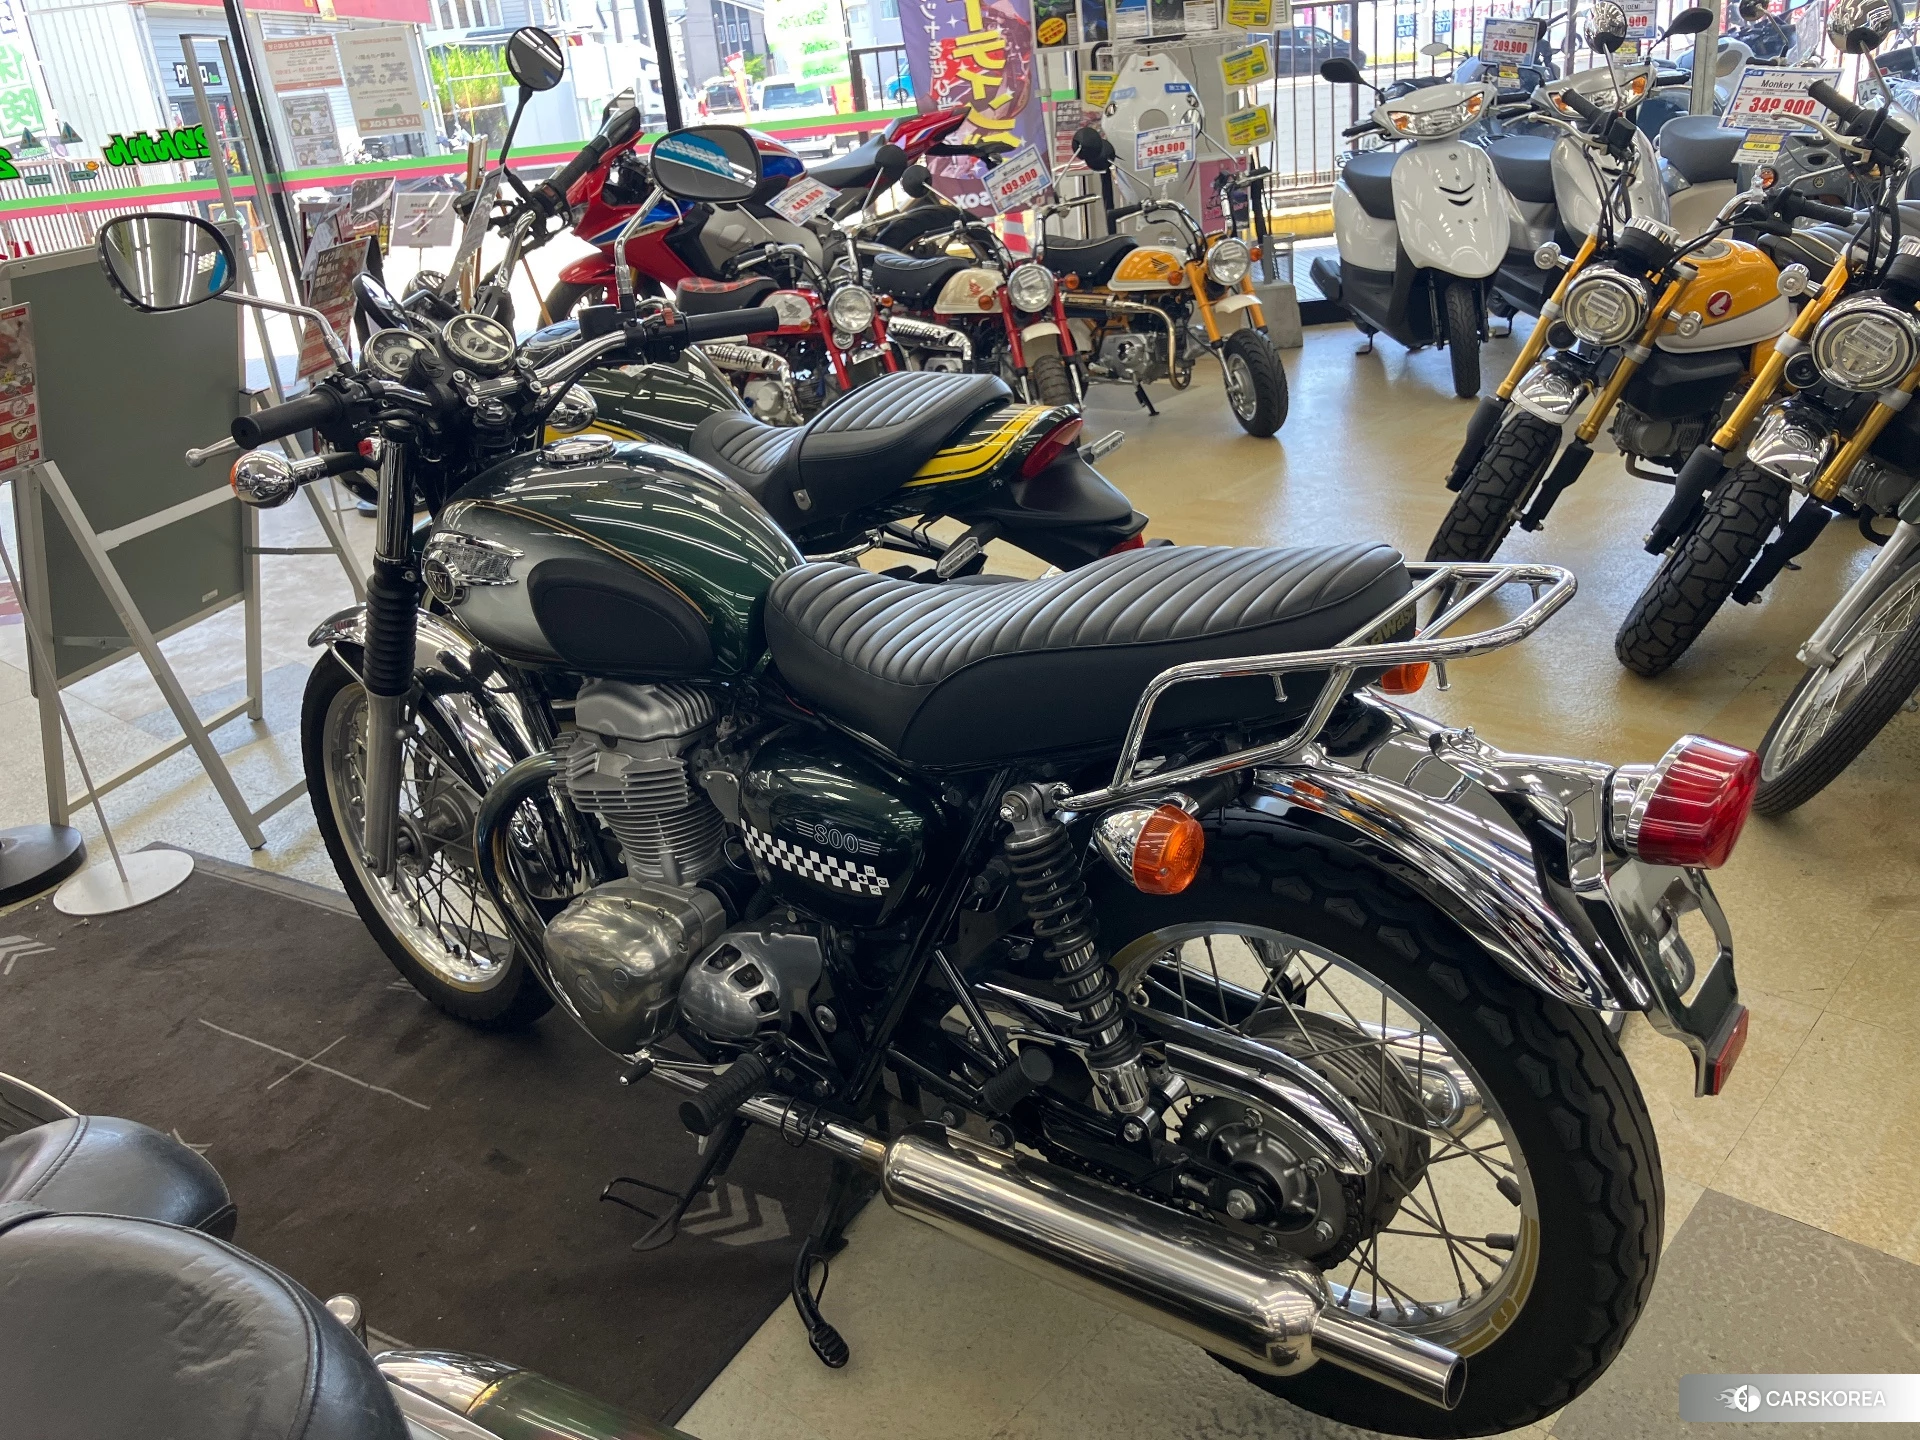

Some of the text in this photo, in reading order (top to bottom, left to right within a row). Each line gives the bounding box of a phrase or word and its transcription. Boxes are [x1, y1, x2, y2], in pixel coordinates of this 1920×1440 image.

[1493, 40, 1528, 54] 209,900
[1761, 80, 1794, 89] Monkey
[1749, 97, 1816, 116] 349900
[1147, 141, 1185, 157] 549,900
[1001, 168, 1038, 196] 499,900
[1370, 602, 1416, 646] awas
[813, 823, 859, 854] 800
